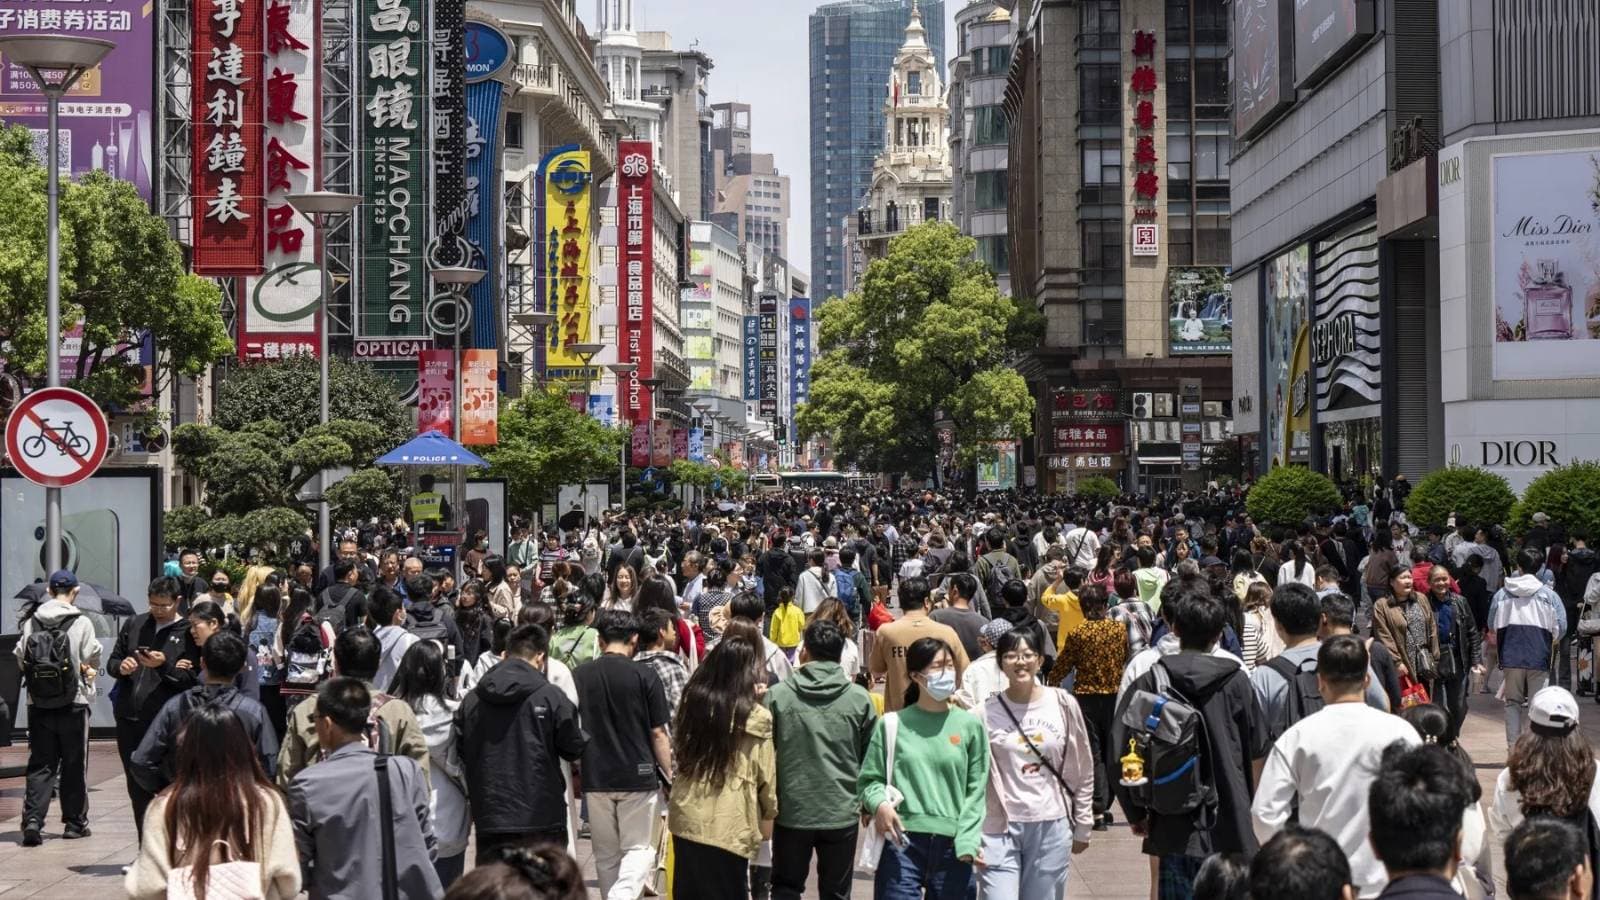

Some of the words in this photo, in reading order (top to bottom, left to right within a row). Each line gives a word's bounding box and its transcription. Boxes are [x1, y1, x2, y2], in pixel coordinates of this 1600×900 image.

[465, 63, 490, 73] MON
[375, 137, 386, 182] SINCE
[1440, 157, 1461, 187] DIOR
[375, 190, 386, 224] 1923
[389, 137, 411, 324] MAOCHANG
[1503, 216, 1549, 238] Miss
[1553, 214, 1593, 236] Dior
[628, 185, 643, 321] 上海市第一食品商店
[630, 329, 641, 352] First
[1312, 313, 1355, 363] SEPHORA
[1058, 428, 1107, 441] 新雅食品
[1480, 440, 1560, 466] DIOR
[891, 645, 912, 659] FEN
